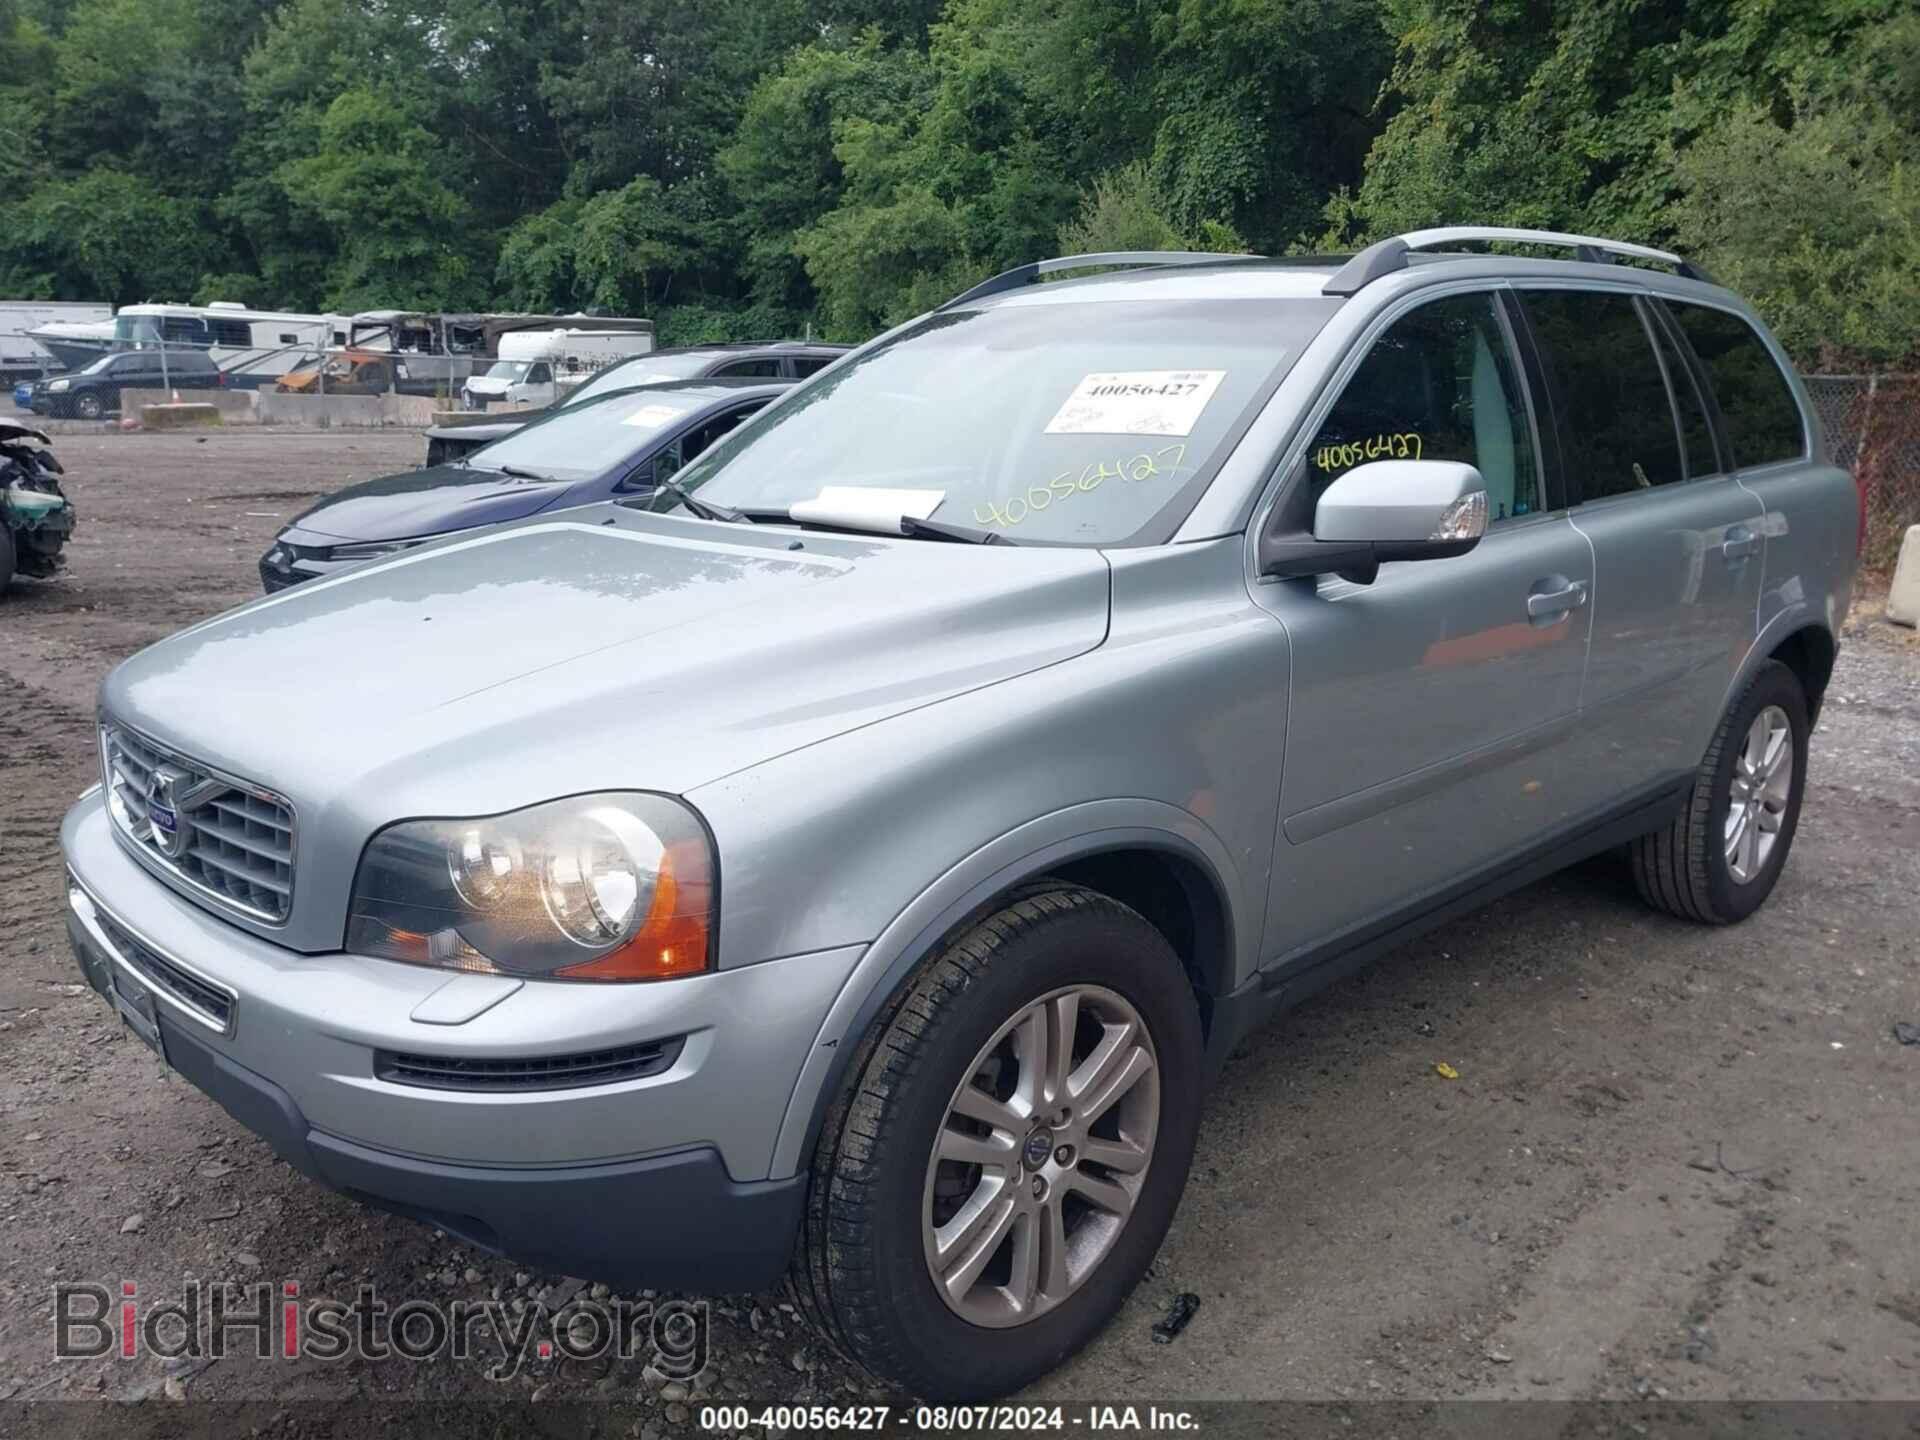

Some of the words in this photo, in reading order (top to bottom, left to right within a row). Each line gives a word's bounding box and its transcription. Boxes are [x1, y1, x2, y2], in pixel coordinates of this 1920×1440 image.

[1087, 383, 1200, 397] 40056427
[1317, 432, 1422, 473] 40056427
[973, 443, 1185, 528] 40056427
